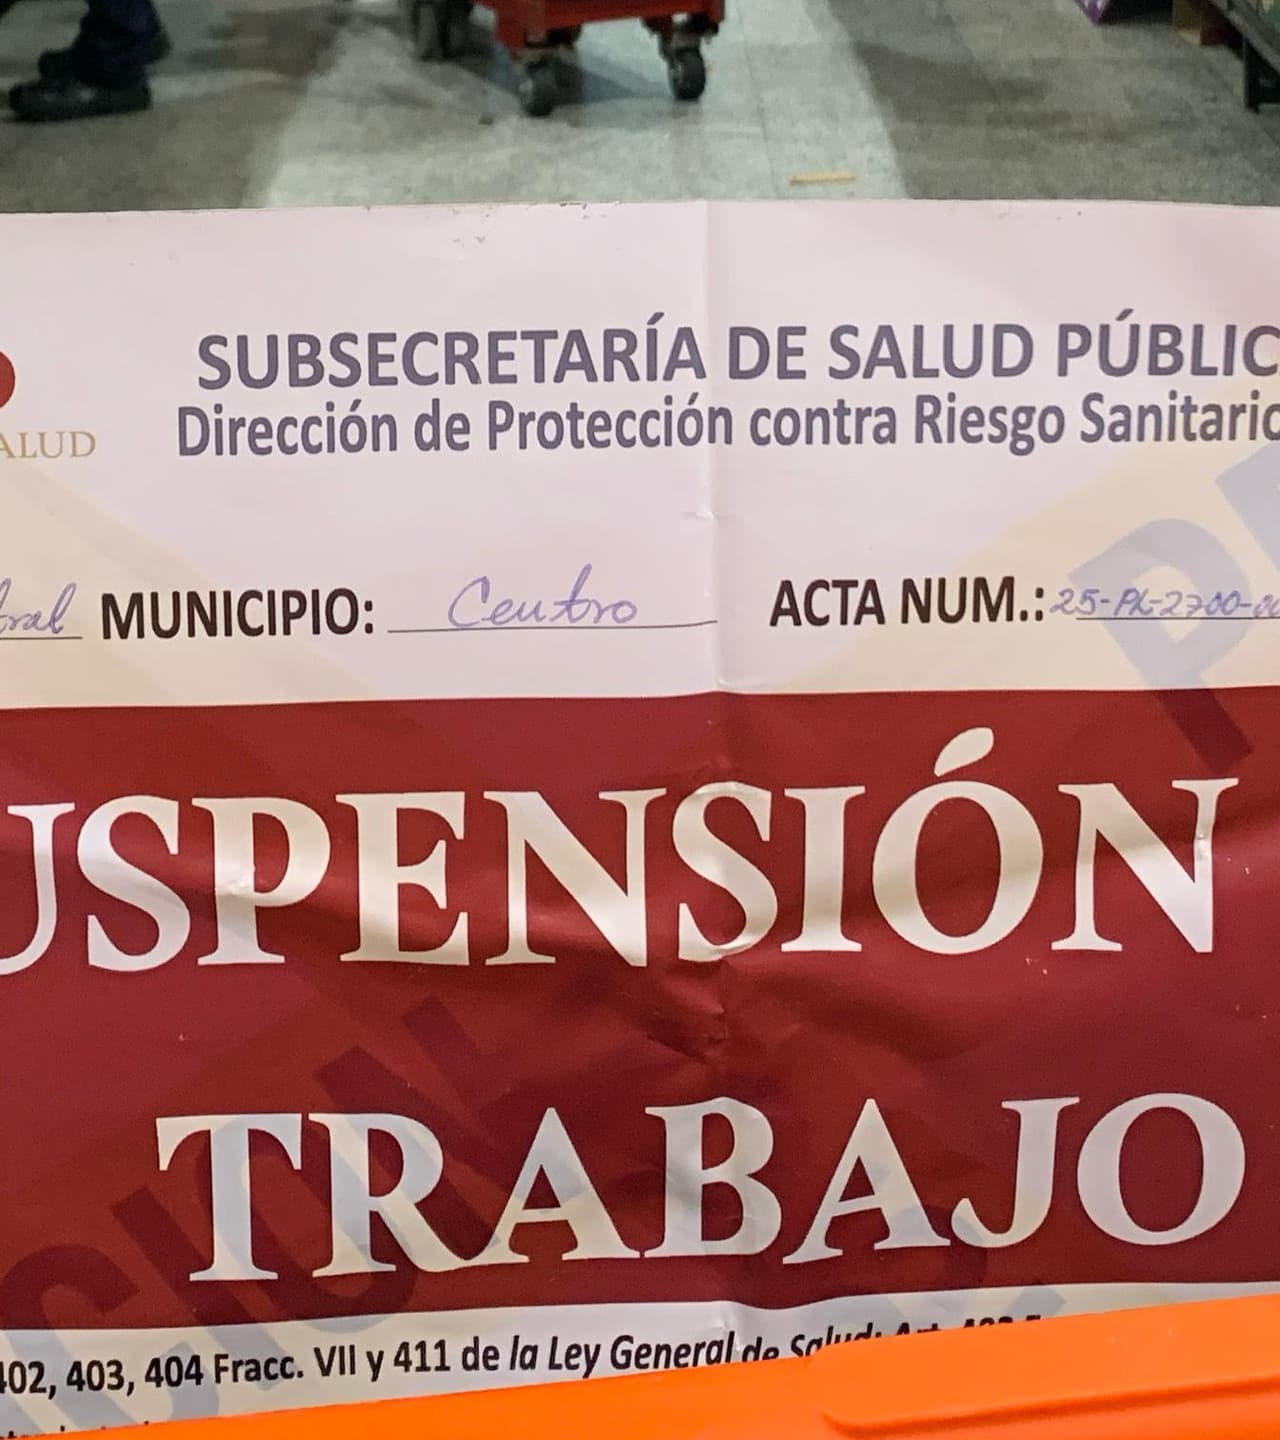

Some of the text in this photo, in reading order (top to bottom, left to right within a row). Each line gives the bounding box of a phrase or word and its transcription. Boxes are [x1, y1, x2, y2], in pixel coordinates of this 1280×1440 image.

[197, 312, 707, 389] SUBSECRETARÍA
[729, 326, 807, 380] DE
[828, 324, 1034, 379] SALUD
[178, 399, 398, 456] Dirección
[414, 398, 471, 452] de
[487, 392, 733, 450] Protección
[750, 399, 897, 445] contra
[914, 392, 1066, 456] Riesgo
[101, 587, 375, 641] MUNICIPIO:
[447, 563, 638, 629] Centro
[770, 575, 1046, 627] ACTA NUM.:
[157, 1091, 1246, 1283] TRABAJO
[67, 1359, 135, 1396] 403,
[145, 1355, 204, 1389] 404
[214, 1350, 304, 1386] Fracc.
[315, 1344, 356, 1378] VII
[366, 1348, 385, 1382] y
[394, 1339, 451, 1373] 411
[462, 1336, 501, 1372] de
[510, 1334, 539, 1371] la
[548, 1337, 599, 1379] Ley
[610, 1332, 738, 1373] General
[742, 1335, 780, 1363] de
